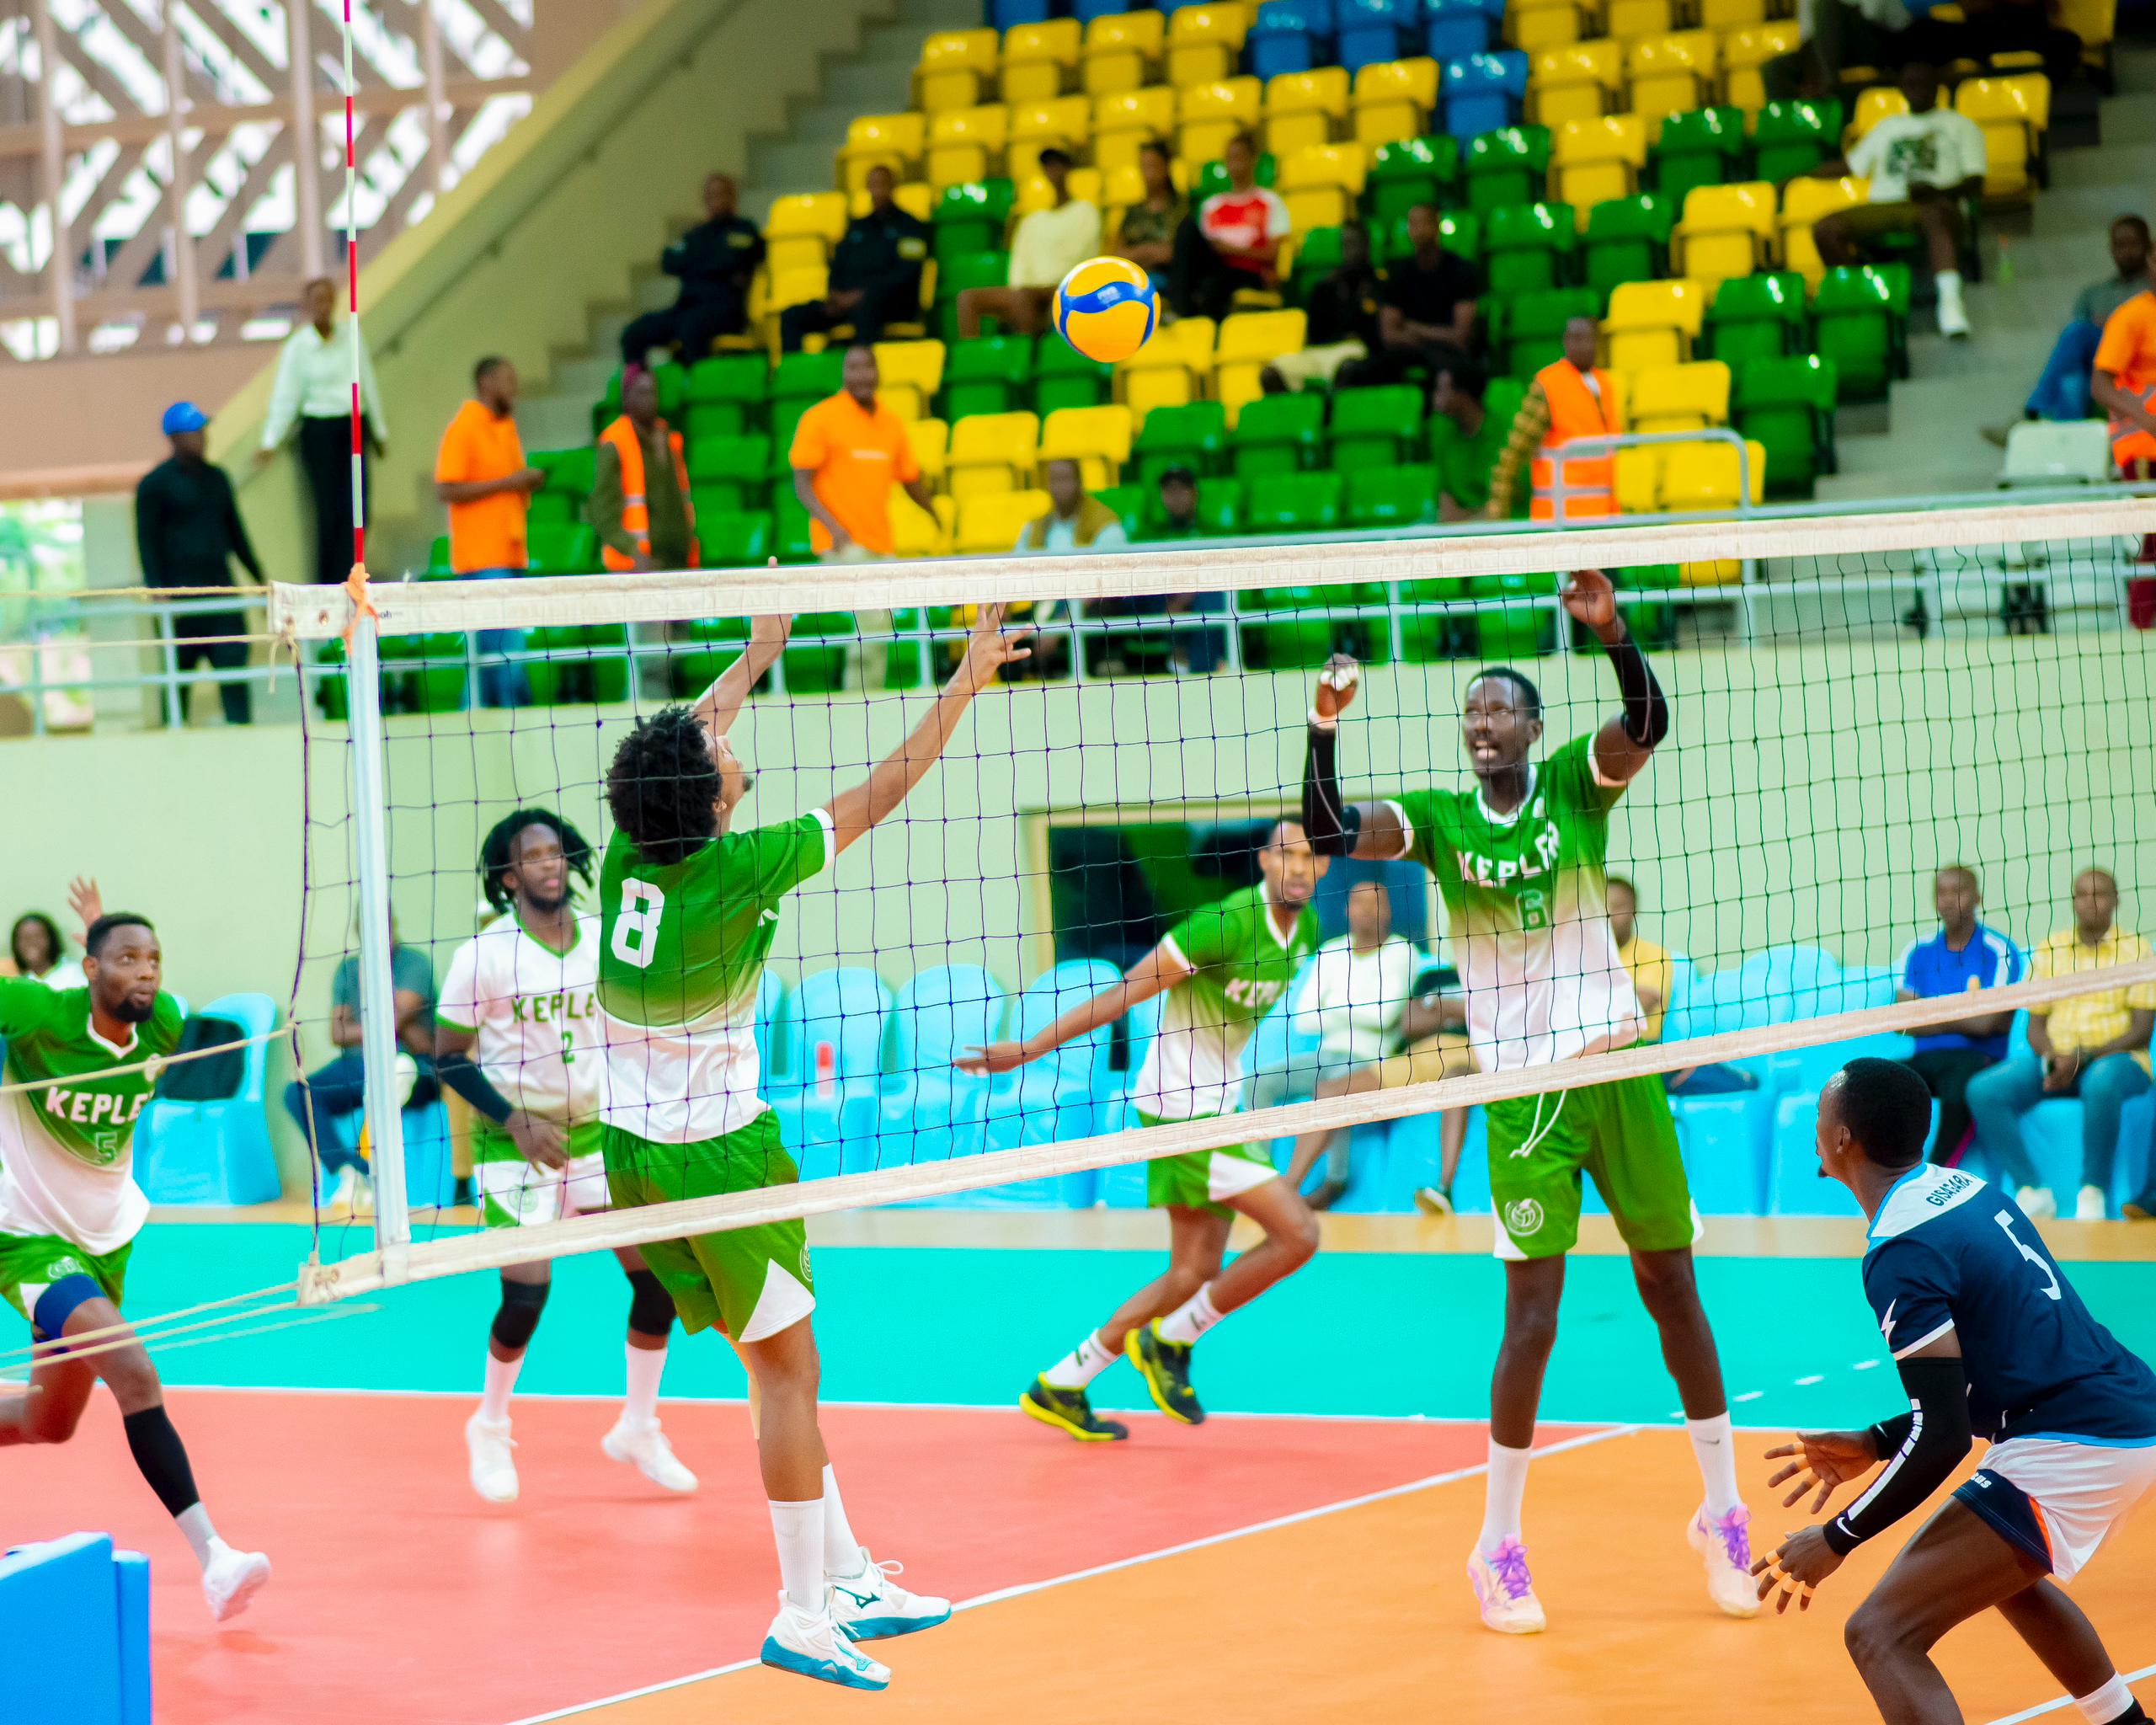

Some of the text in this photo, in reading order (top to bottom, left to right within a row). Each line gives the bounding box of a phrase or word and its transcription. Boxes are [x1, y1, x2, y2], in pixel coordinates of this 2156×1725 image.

[611, 877, 665, 969] 8
[511, 992, 595, 1024] KEPLE
[561, 1030, 576, 1065] 2
[45, 1085, 154, 1125] KEPLE
[94, 1131, 119, 1165] 5
[1993, 1209, 2062, 1300] 5
